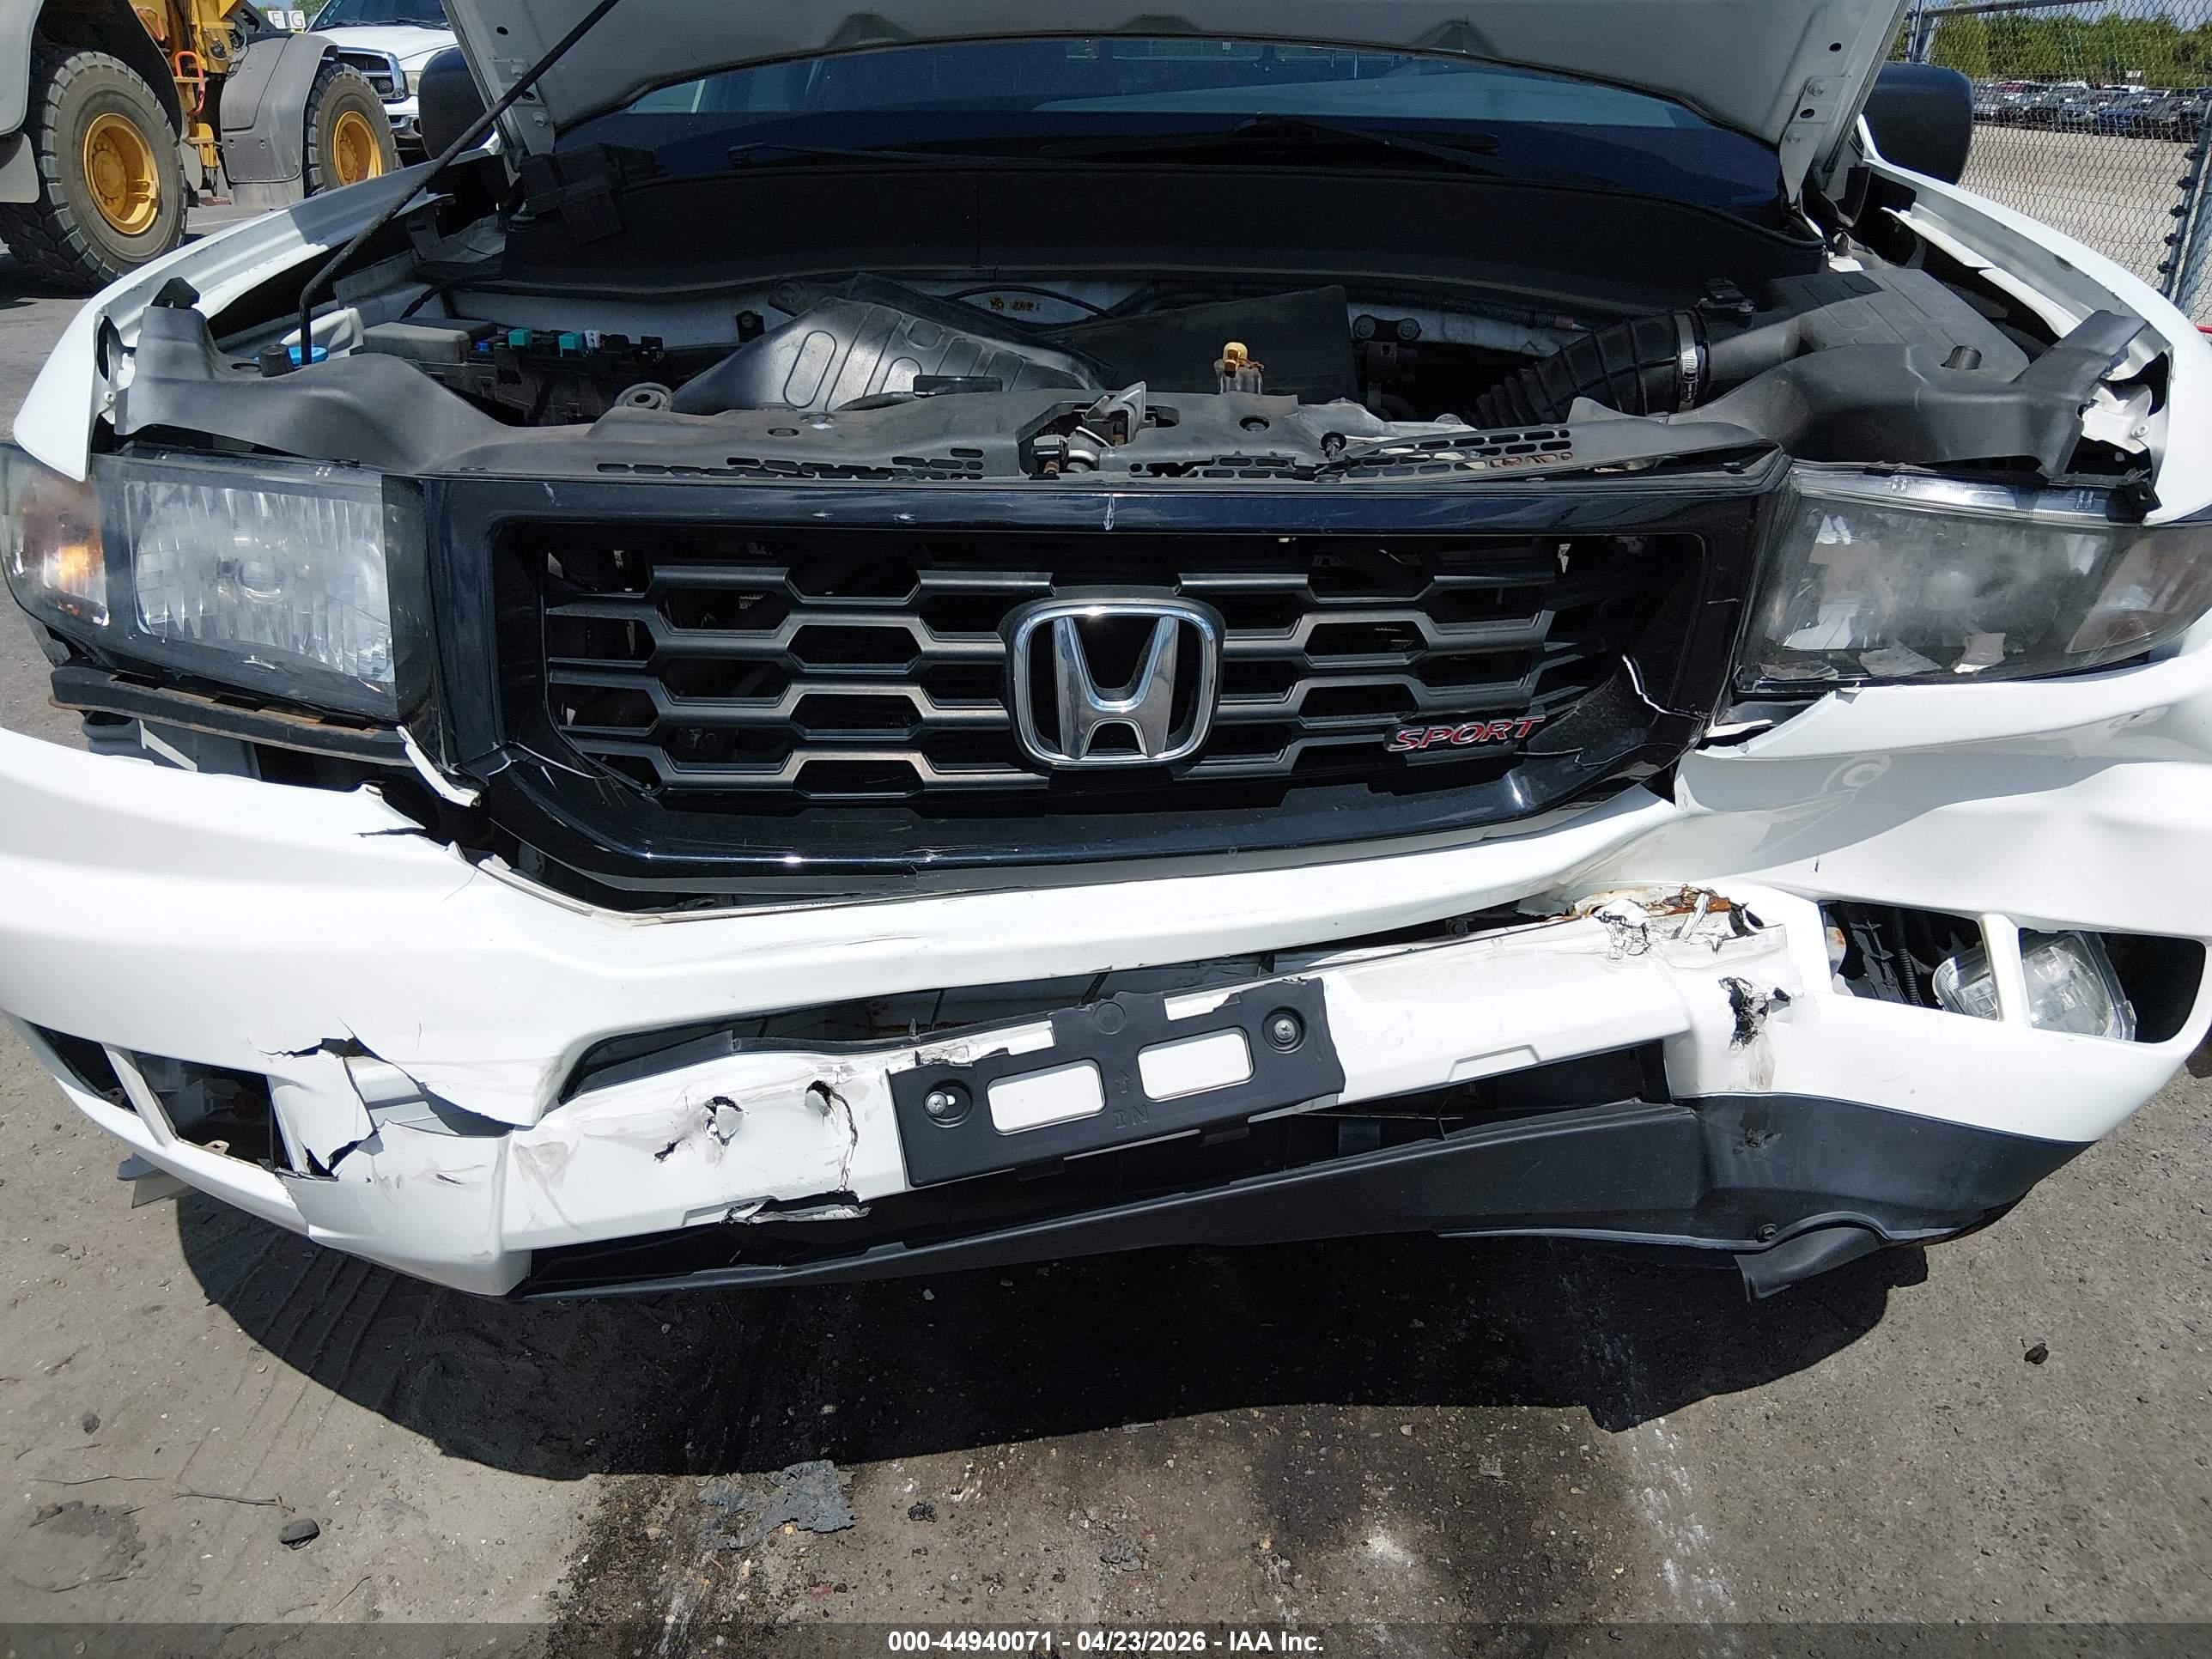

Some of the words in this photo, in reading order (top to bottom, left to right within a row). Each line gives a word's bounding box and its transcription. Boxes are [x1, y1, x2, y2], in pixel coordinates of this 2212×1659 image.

[271, 12, 282, 26] F
[292, 12, 304, 27] G
[1388, 714, 1546, 752] SPORT
